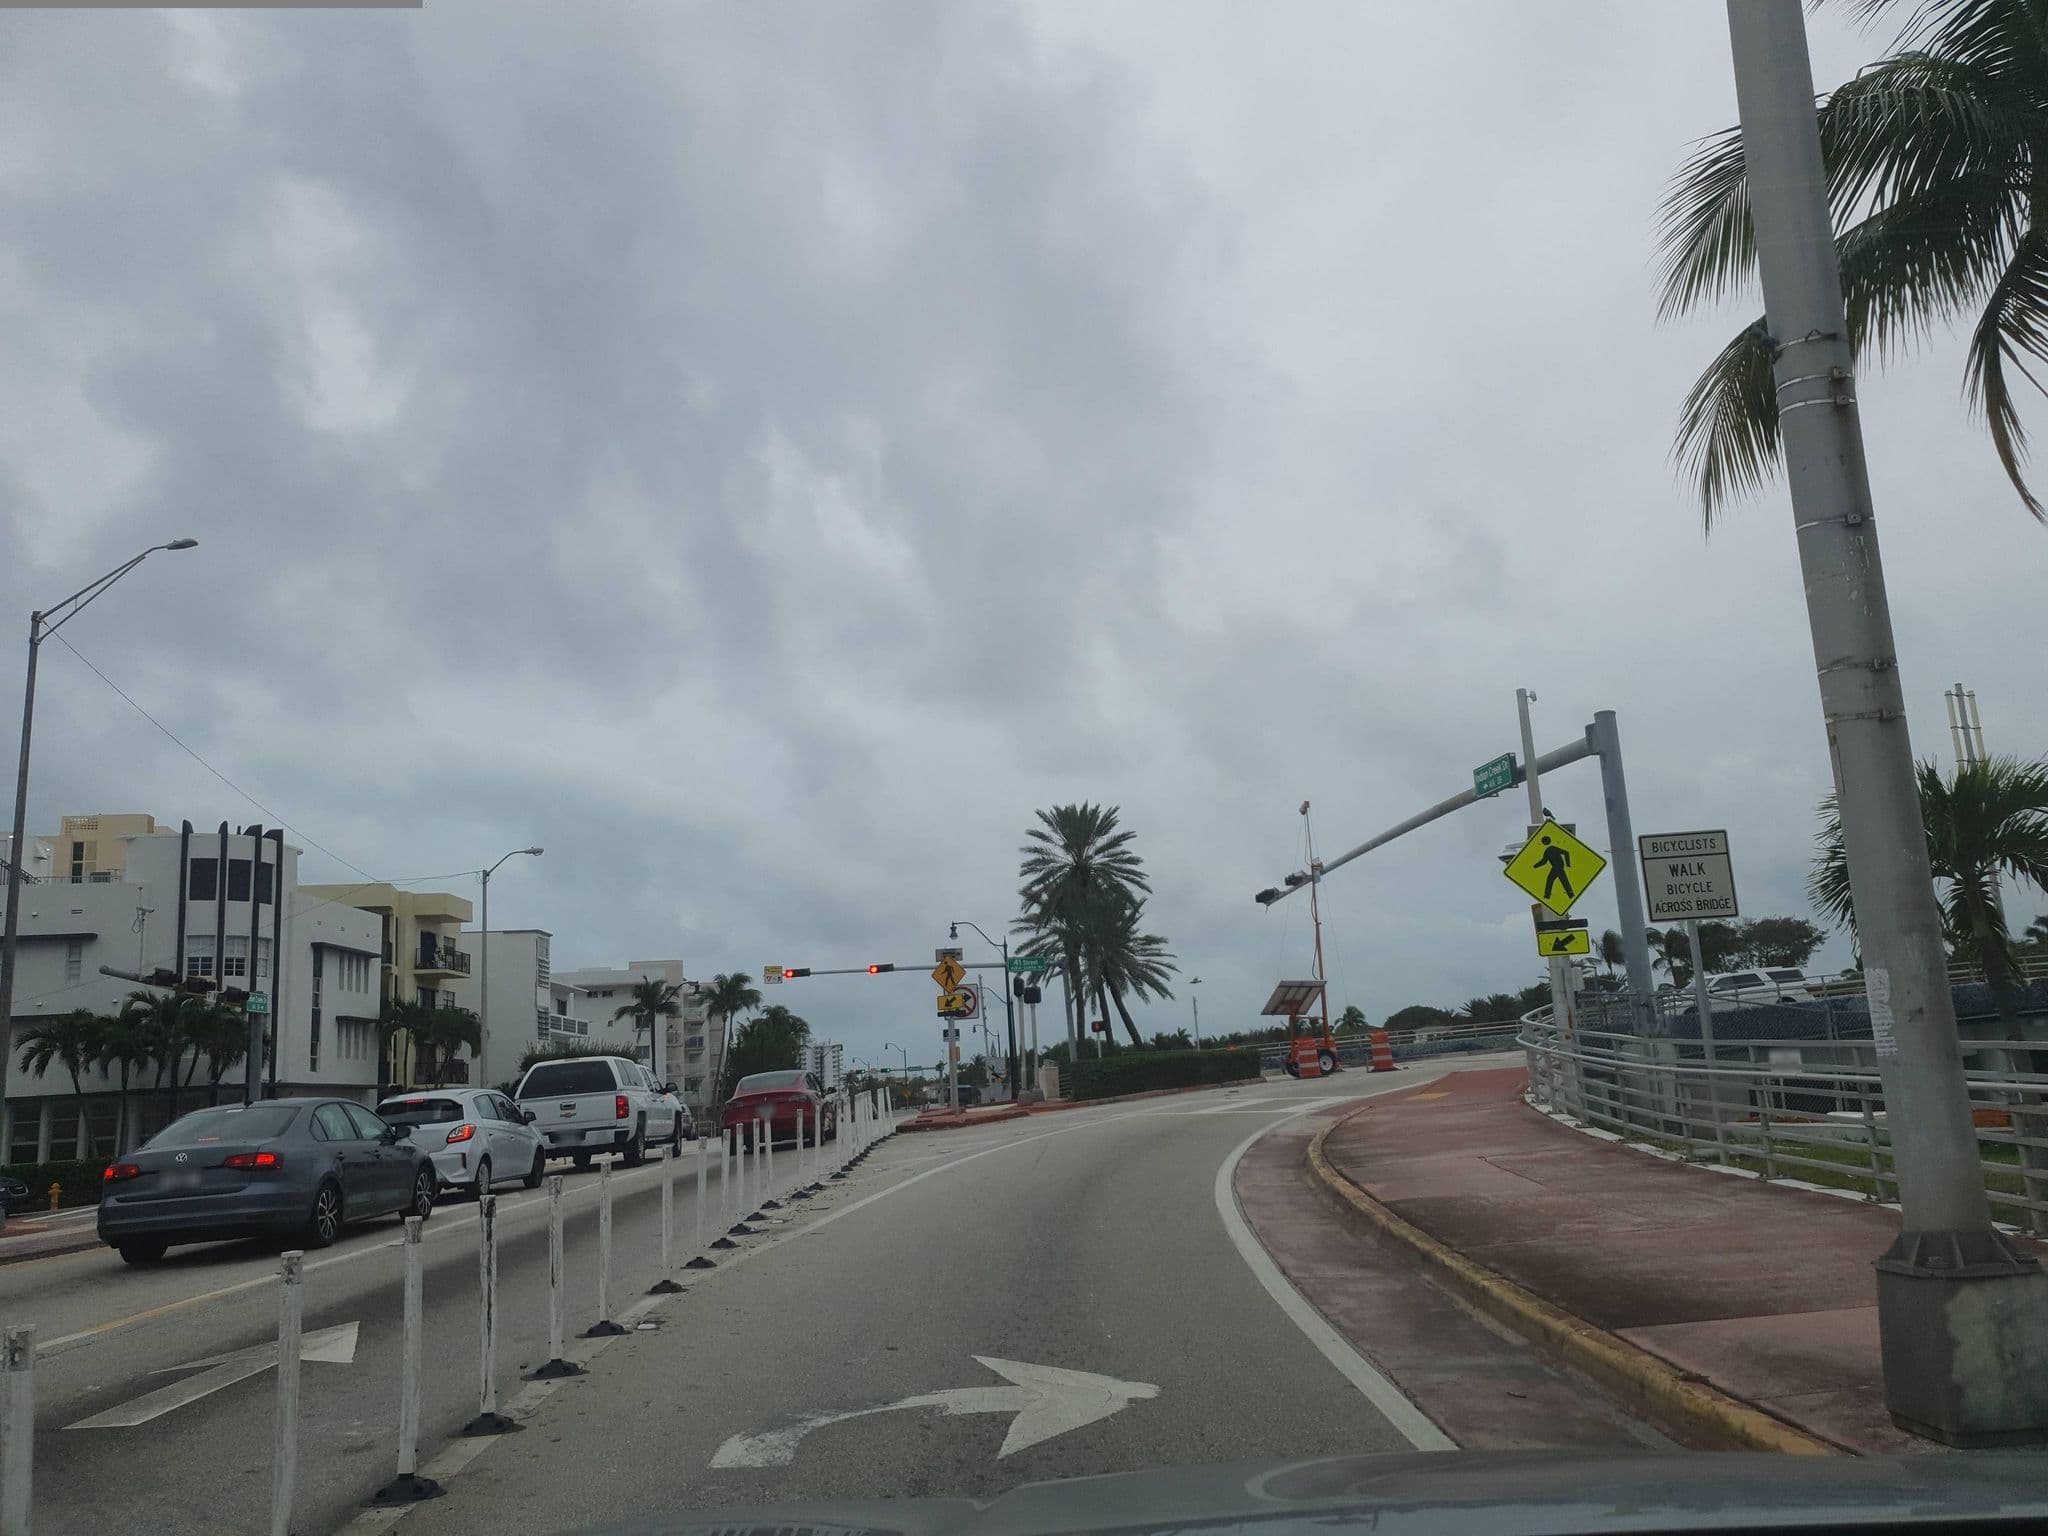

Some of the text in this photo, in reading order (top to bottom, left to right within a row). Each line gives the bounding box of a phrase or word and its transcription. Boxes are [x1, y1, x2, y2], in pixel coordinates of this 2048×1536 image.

[1489, 763, 1502, 777] Creek
[1651, 838, 1716, 853] BICYCLISTS
[1669, 862, 1706, 878] WALK
[1667, 881, 1713, 895] BICYCLE
[1655, 897, 1732, 913] ACROSS BRIDGE
